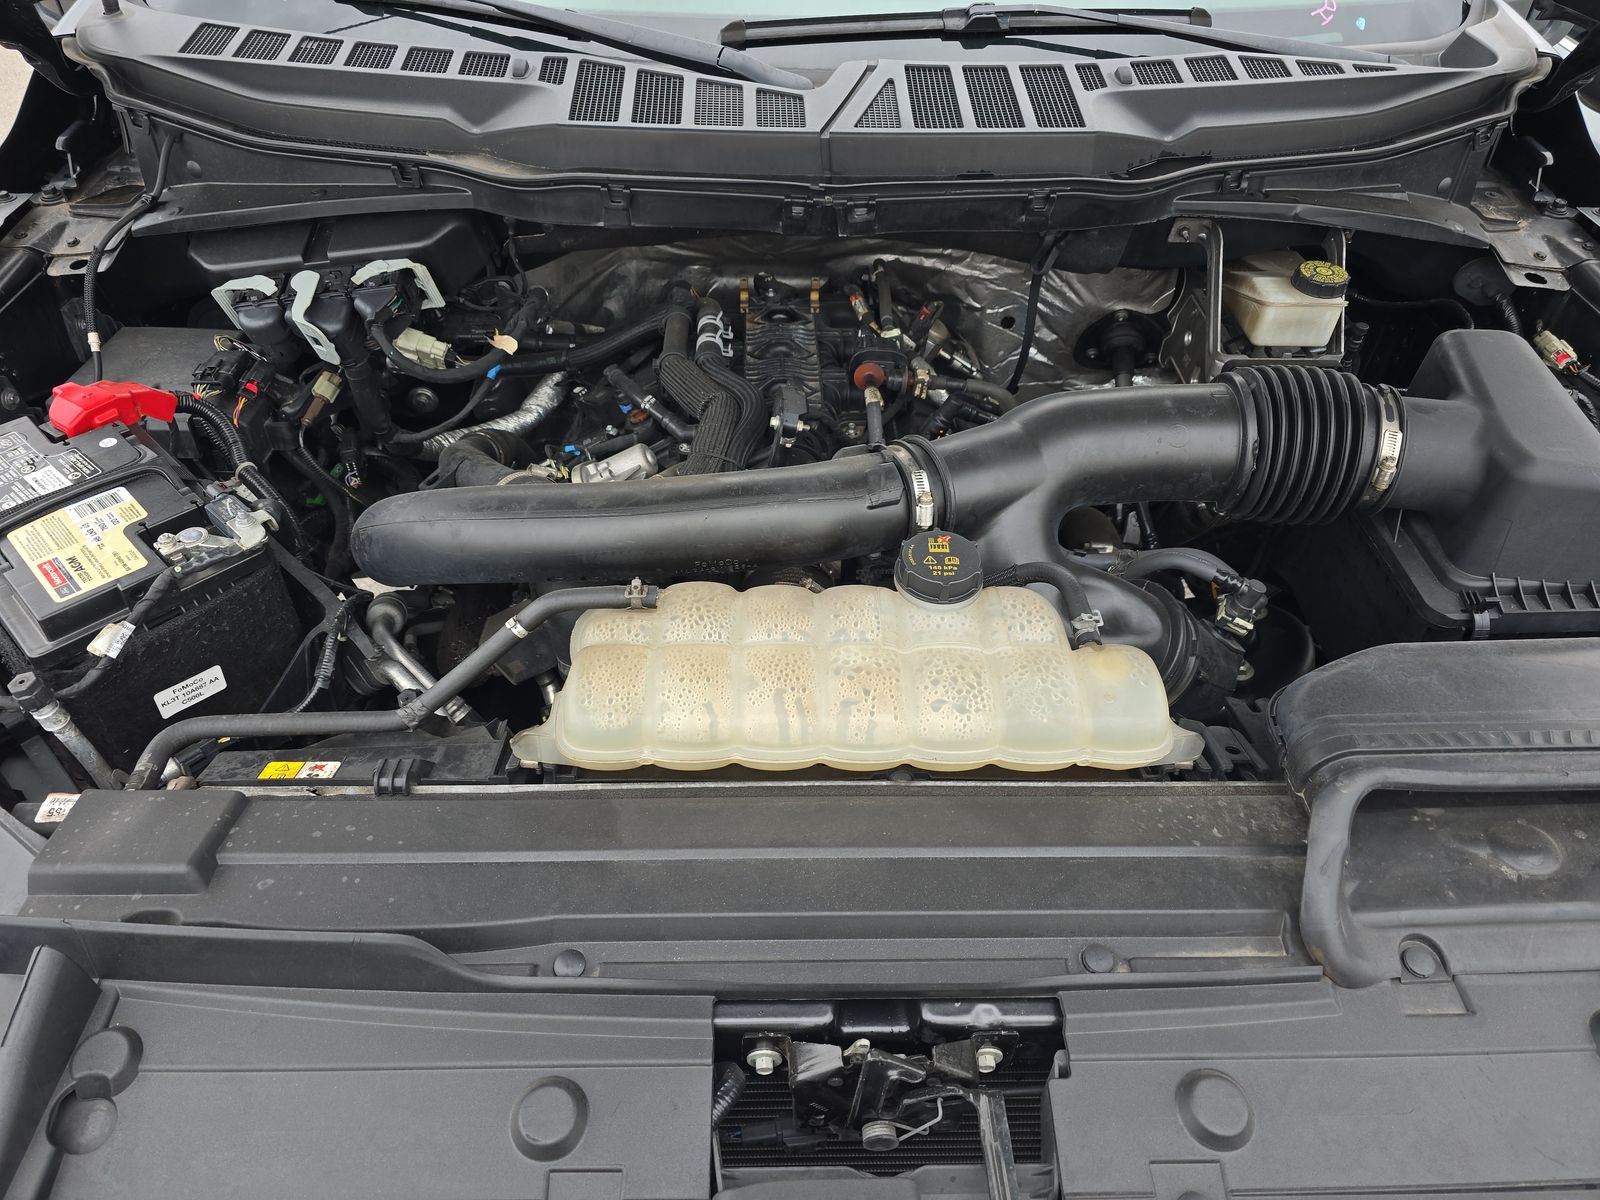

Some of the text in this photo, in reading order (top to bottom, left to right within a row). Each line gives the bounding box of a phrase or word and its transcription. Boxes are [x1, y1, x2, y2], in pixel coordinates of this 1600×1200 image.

[65, 555, 86, 572] AGM
[42, 562, 63, 585] Motorcraft
[161, 695, 180, 708] KL3T
[209, 676, 220, 685] AA
[172, 677, 204, 695] FoMoCo
[181, 692, 205, 705] C500L
